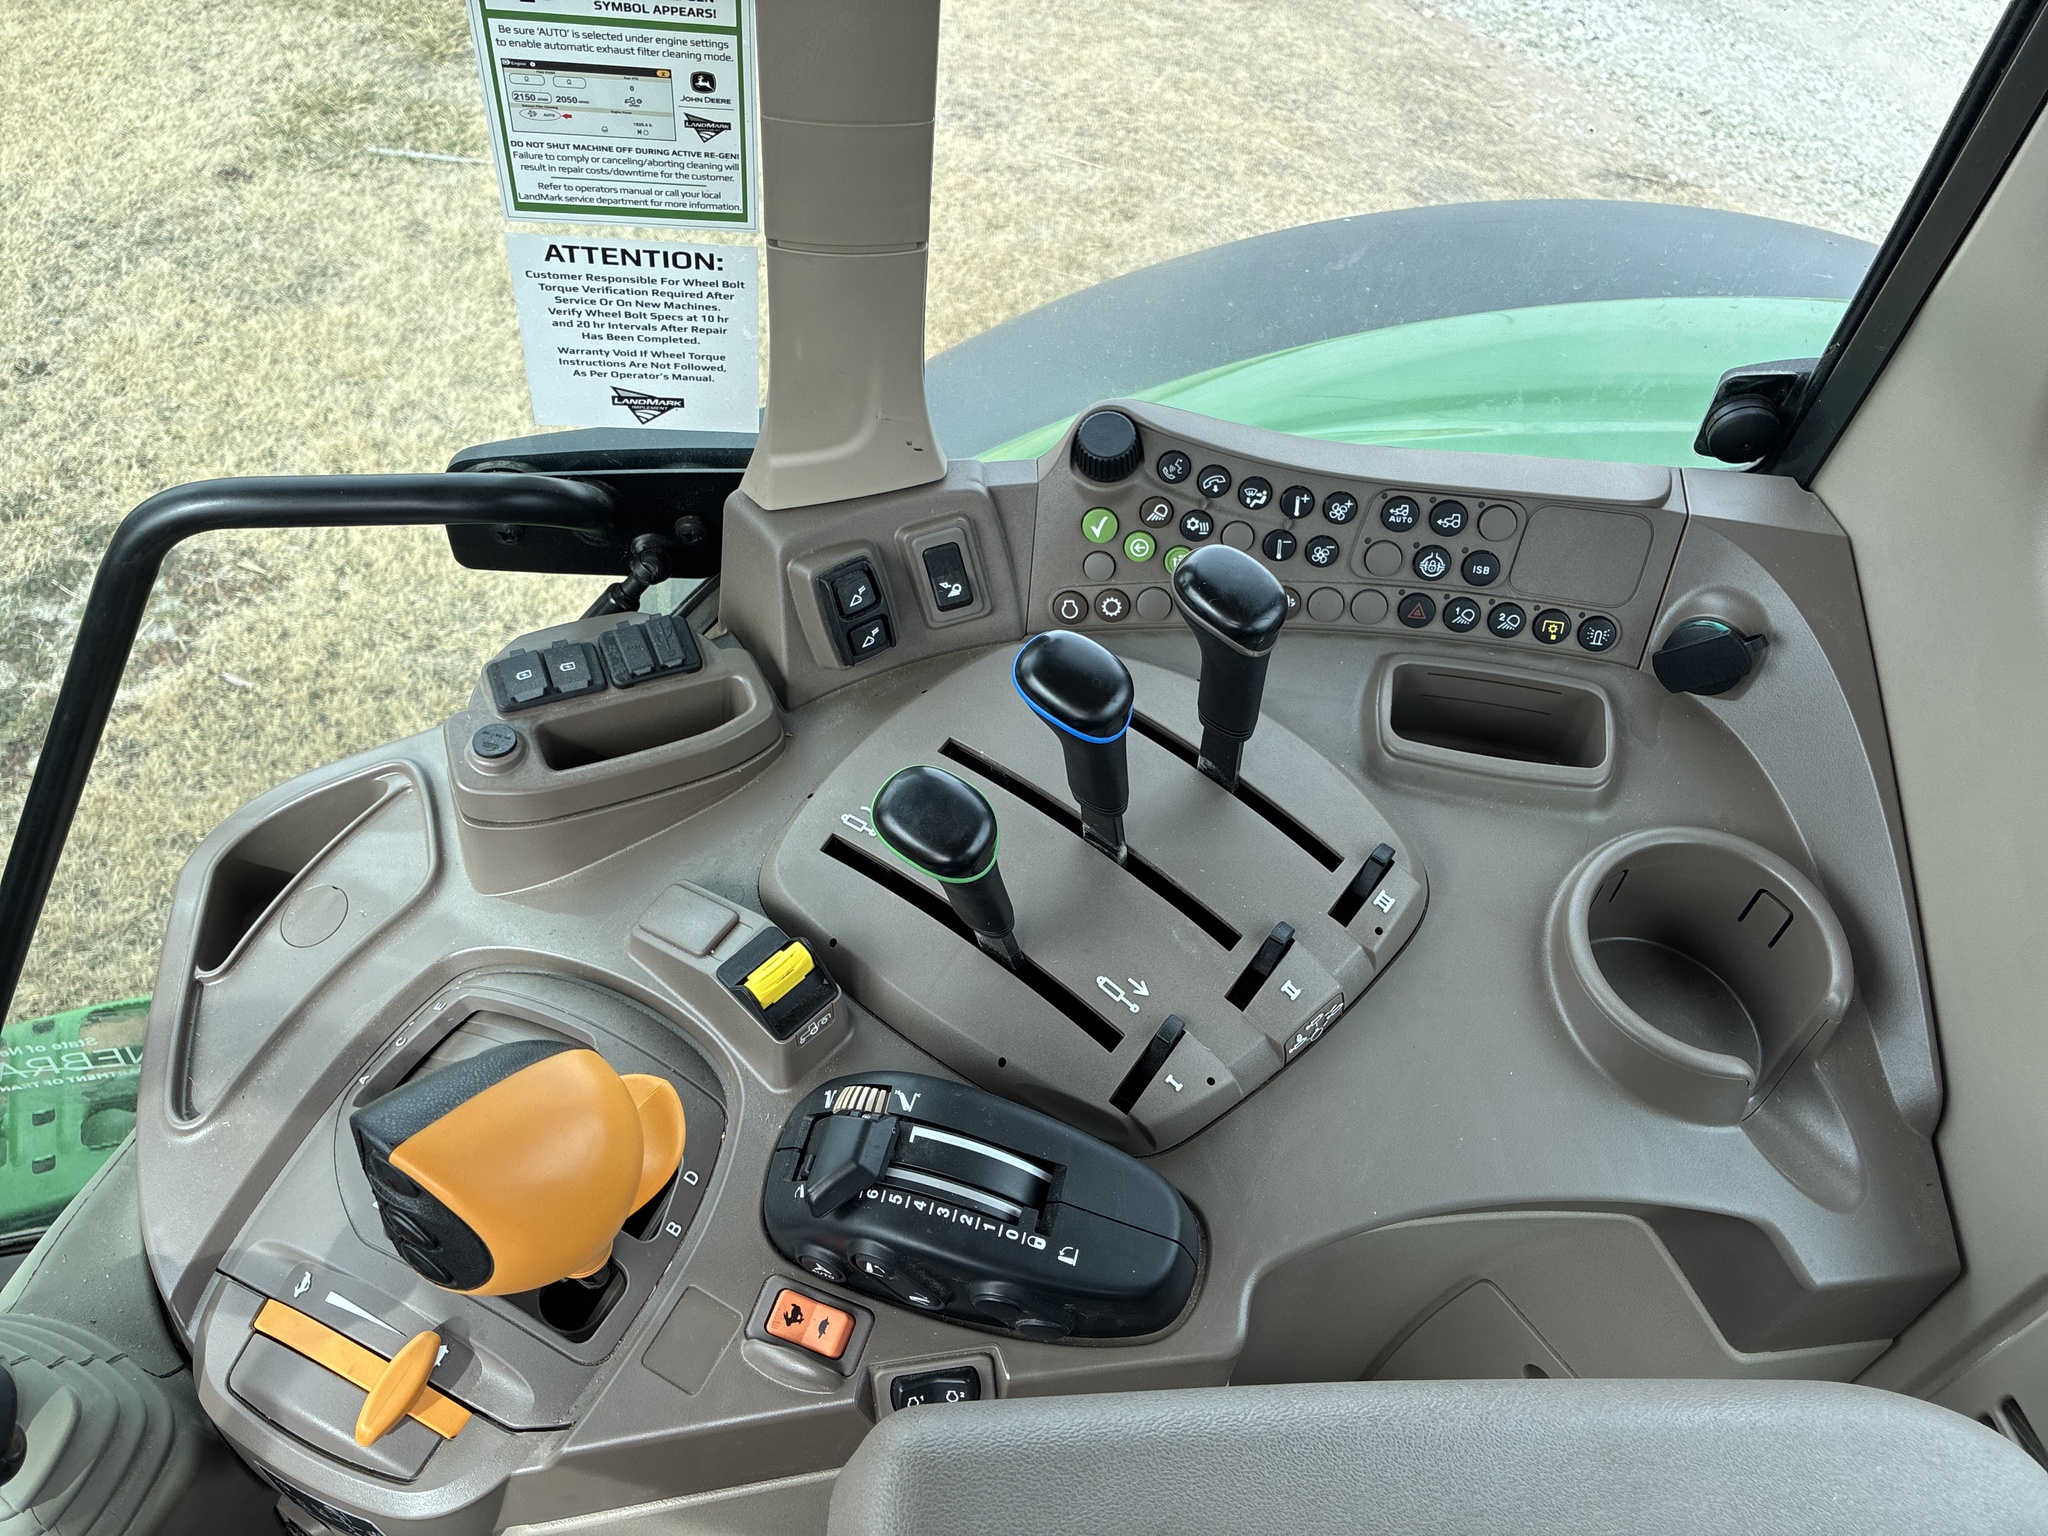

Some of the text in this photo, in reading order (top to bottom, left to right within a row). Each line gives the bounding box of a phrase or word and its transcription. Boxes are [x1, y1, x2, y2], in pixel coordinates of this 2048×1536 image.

[594, 1, 717, 18] SYMBOL APPEARS!
[498, 25, 511, 34] Be
[513, 27, 535, 36] sure
[572, 30, 580, 39] is
[582, 31, 622, 41] selected
[625, 34, 654, 44] under
[655, 37, 688, 48] engine
[690, 39, 729, 50] settings
[496, 38, 734, 62] to enable automatic exhaust filter cleaning mode.
[513, 93, 536, 101] 2150
[555, 96, 578, 104] 2050
[680, 95, 703, 103] JOHN
[510, 140, 524, 148] DO
[526, 141, 544, 149] NOT
[546, 142, 571, 150] SHUT
[573, 144, 614, 152] MACHINE
[635, 148, 670, 156] DURING
[671, 150, 703, 158] ACTIVE
[704, 152, 740, 160] RE-GEN!
[513, 151, 543, 160] Failure
[545, 153, 555, 161] to
[556, 154, 589, 164] comply
[602, 157, 685, 170] canceling/aborting
[686, 162, 723, 172] cleaning
[724, 163, 740, 171] will
[520, 164, 735, 182] result in repair costs/downtime for the customer.
[537, 182, 562, 190] Refer
[563, 183, 574, 192] to
[575, 185, 618, 194] operators
[619, 187, 653, 196] manual
[665, 189, 680, 197] call
[681, 191, 700, 200] your
[701, 190, 721, 199] local
[518, 193, 742, 211] LandMark service department for more information.
[544, 244, 723, 271] ATTENTION:
[525, 270, 746, 289] Customer Responsible For Wheel Bolt
[538, 283, 735, 301] Torque Verification Required After
[554, 296, 721, 312] Service Or On New Machines.
[547, 307, 729, 323] Verify Wheel Bolt Specs at 10 hr
[552, 319, 728, 336] and 20 hr Intervals After Repair
[581, 332, 701, 345] Has Been Completed.
[557, 346, 726, 363] Warranty Void If Wheel Torque
[558, 358, 727, 373] Instructions Are Not Followed,
[572, 369, 715, 383] As Per Operator's Manual.
[1388, 515, 1413, 524] AUTO
[1472, 565, 1490, 575] ISB
[1455, 607, 1460, 615] 1
[1498, 613, 1506, 621] 2
[433, 1002, 447, 1011] E
[395, 1037, 407, 1047] C
[358, 1075, 370, 1085] A
[683, 1170, 699, 1186] D
[866, 1189, 879, 1200] 6
[888, 1193, 903, 1206] 5
[913, 1200, 927, 1211] 4
[936, 1207, 950, 1218] 3
[959, 1214, 974, 1226] 2
[983, 1223, 996, 1231] 1
[665, 1221, 682, 1238] B
[811, 1269, 835, 1280] AUTO
